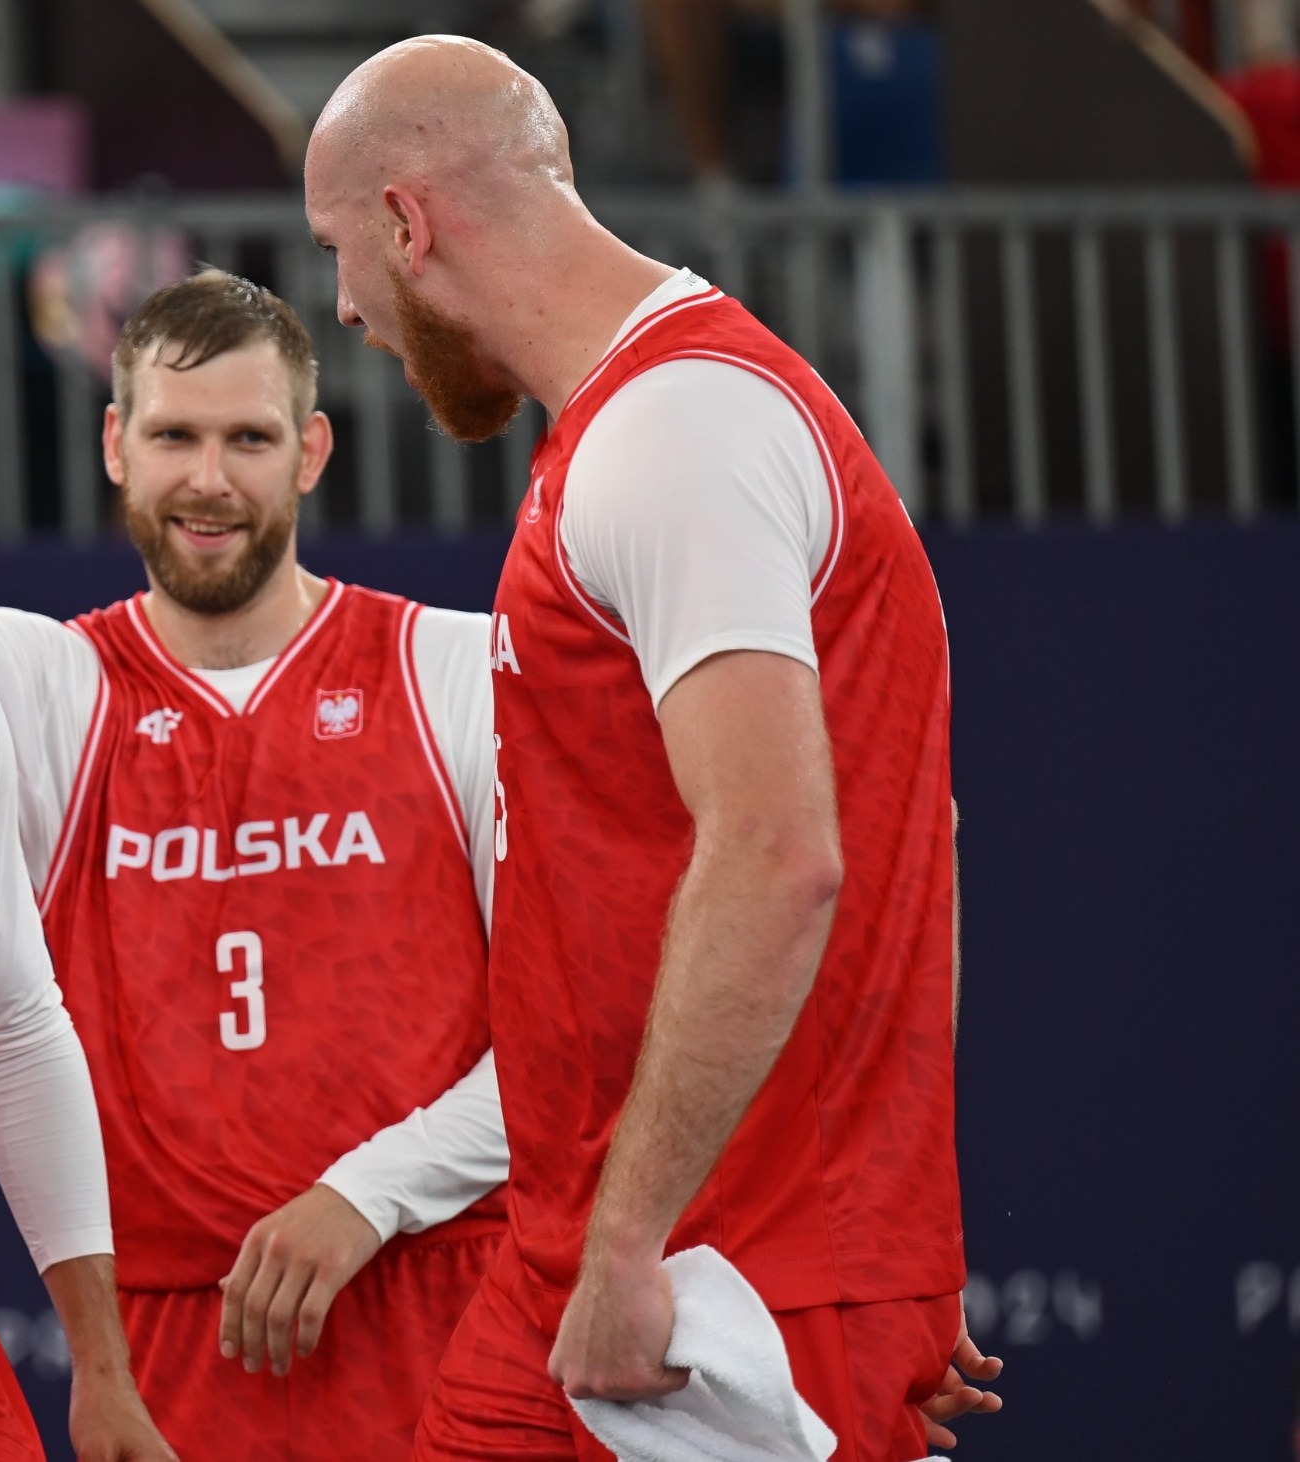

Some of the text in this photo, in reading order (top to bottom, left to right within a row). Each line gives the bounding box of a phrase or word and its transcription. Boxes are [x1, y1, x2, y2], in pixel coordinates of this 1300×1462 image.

[135, 707, 184, 744] 4F
[106, 811, 386, 882] POLSKA
[216, 930, 267, 1051] 3
